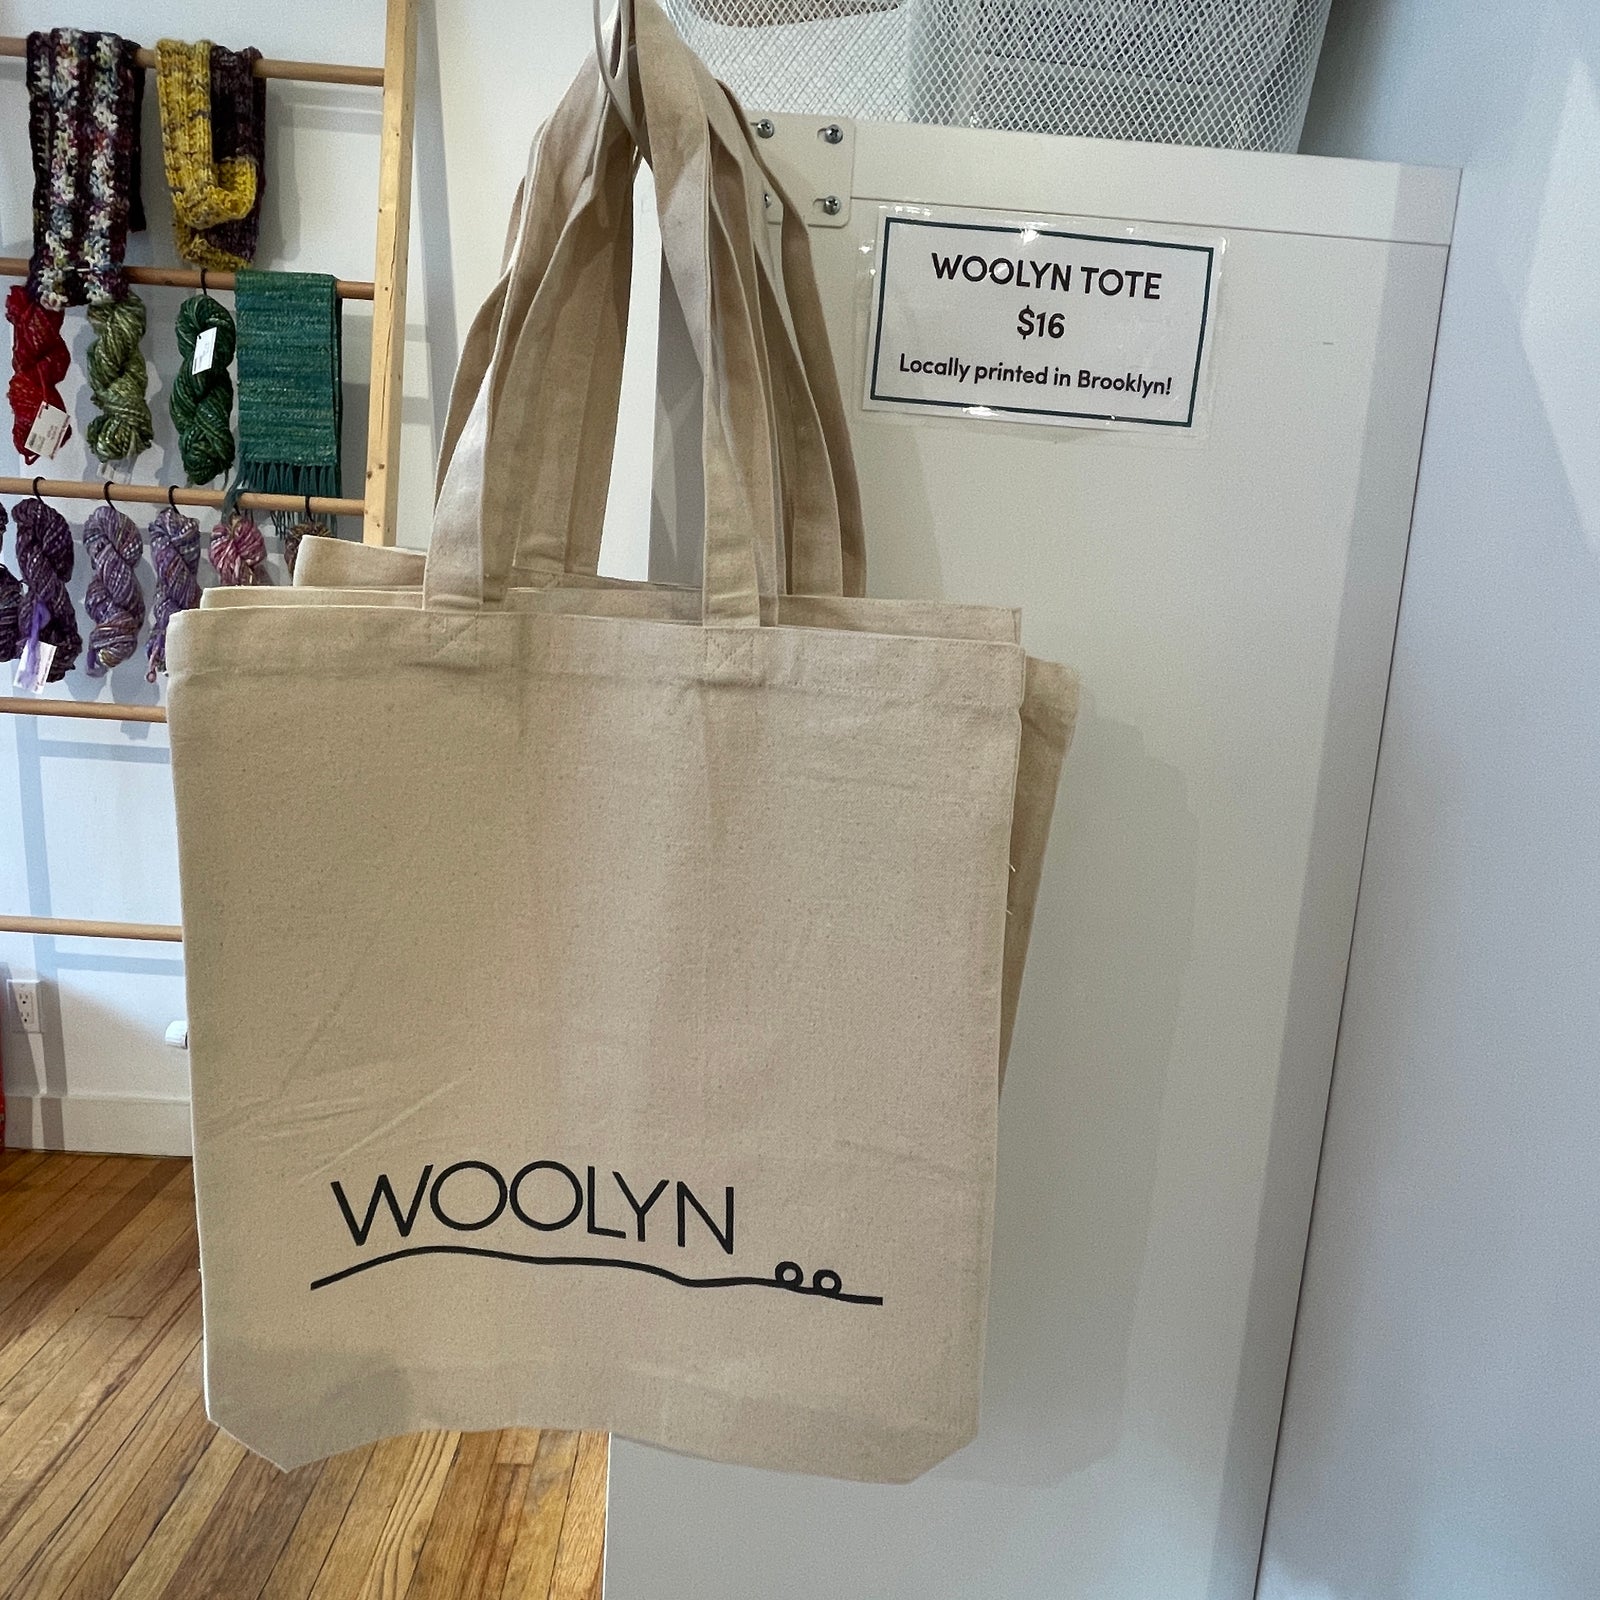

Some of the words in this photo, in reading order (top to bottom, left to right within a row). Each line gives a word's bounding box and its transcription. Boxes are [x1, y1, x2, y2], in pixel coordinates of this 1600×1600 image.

[931, 252, 1072, 292] WOOLYN
[1080, 266, 1163, 299] TOTE
[1016, 305, 1065, 340] $16
[899, 353, 971, 382] Locally
[974, 362, 1048, 385] printed
[1053, 367, 1072, 387] in
[1077, 370, 1173, 399] Brooklyn!
[331, 1160, 734, 1254] WOOLYN
